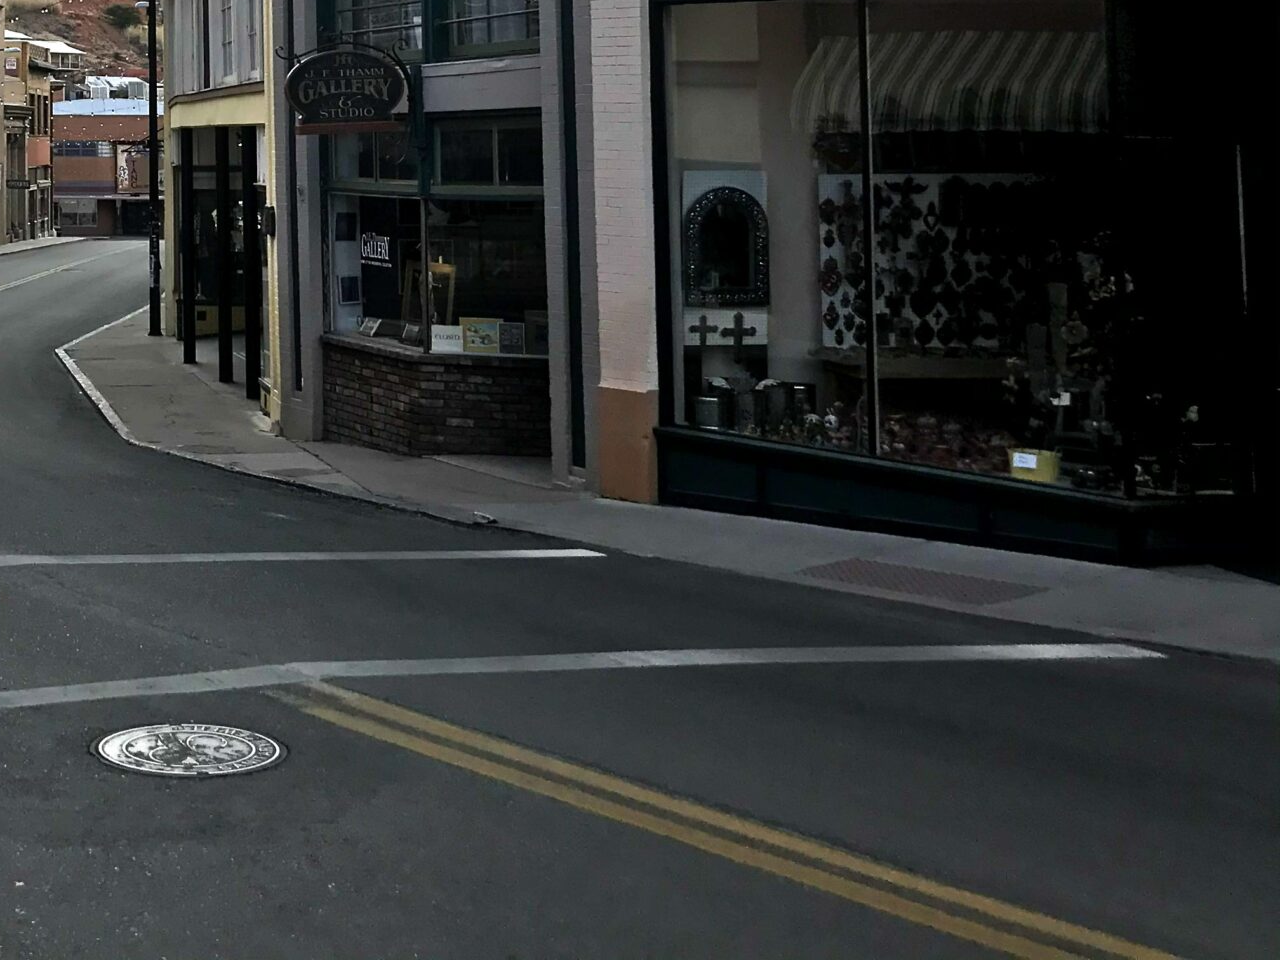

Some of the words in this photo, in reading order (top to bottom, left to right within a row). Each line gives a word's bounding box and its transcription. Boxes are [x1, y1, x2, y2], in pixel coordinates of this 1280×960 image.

[339, 67, 384, 77] THAMM
[298, 79, 392, 104] GALLERY
[320, 106, 375, 119] STUDIO
[361, 233, 390, 260] GALLERY
